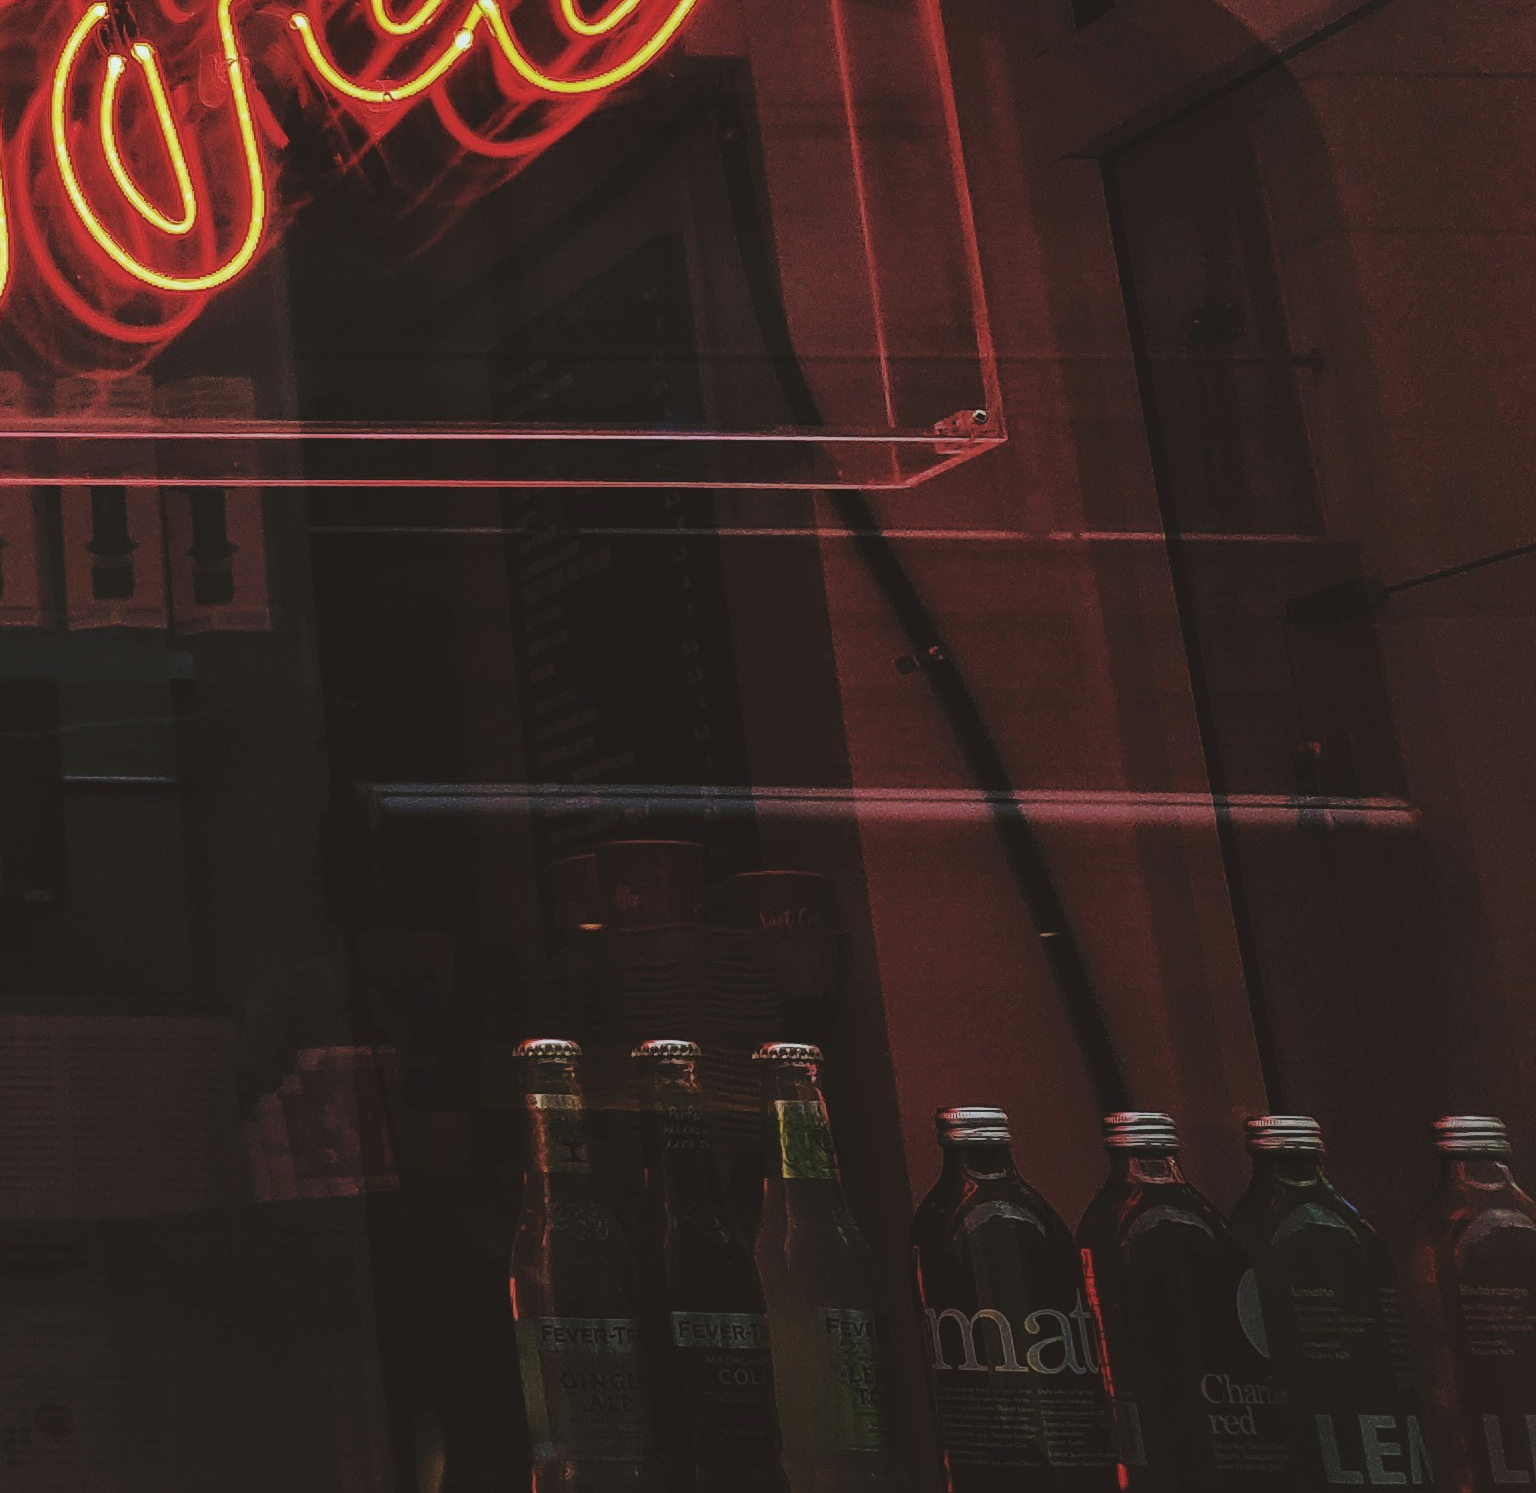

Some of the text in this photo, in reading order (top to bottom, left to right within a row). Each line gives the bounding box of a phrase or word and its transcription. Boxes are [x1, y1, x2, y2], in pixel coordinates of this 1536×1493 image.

[540, 1323, 639, 1345] FEVER-TR
[678, 1319, 768, 1343] FEVER-T
[924, 1287, 1101, 1375] mat
[1206, 1405, 1259, 1436] red
